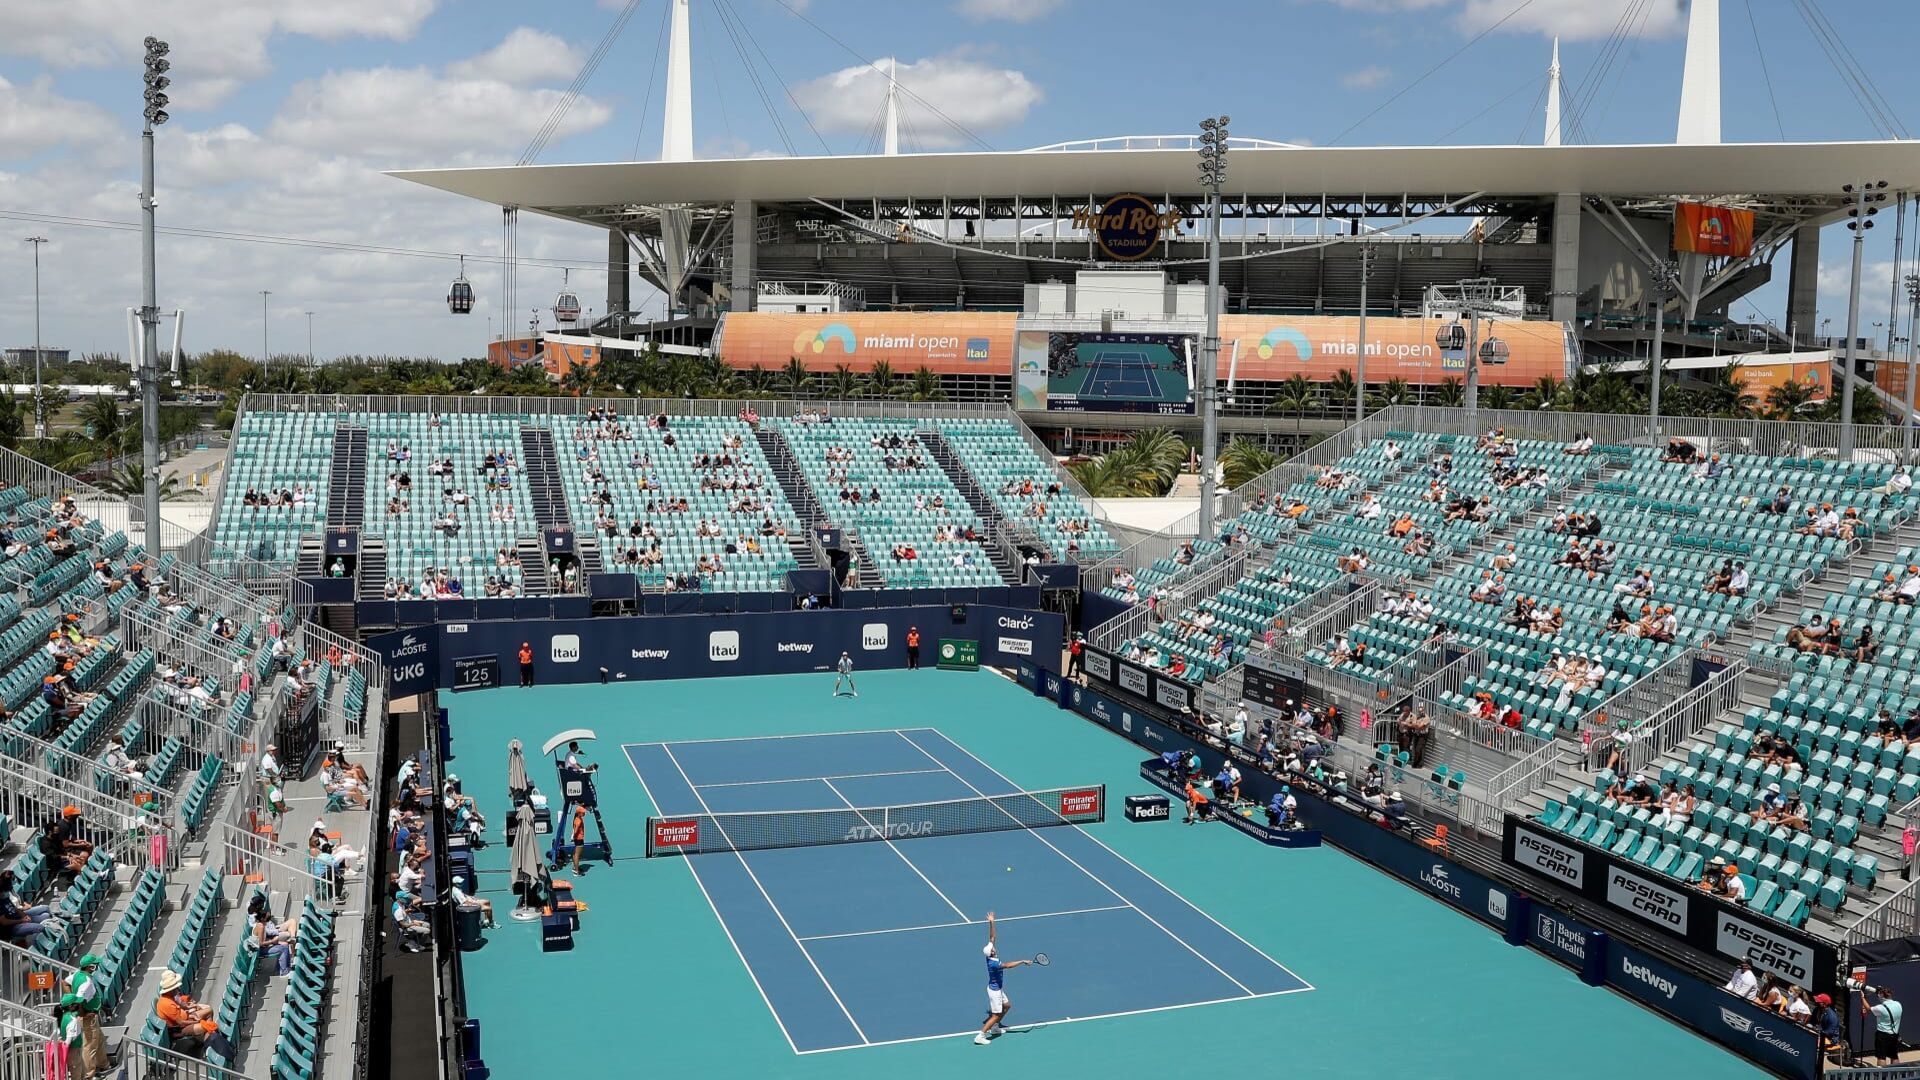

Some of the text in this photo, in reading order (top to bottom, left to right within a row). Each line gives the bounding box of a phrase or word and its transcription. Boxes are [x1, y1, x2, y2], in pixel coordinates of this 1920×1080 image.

[1072, 207, 1181, 235] Hard Rock
[1108, 239, 1147, 247] STADIUM
[864, 334, 958, 351] miami open
[1321, 339, 1431, 360] miami open
[967, 349, 988, 358] Itaú
[1443, 356, 1465, 368] Itaú
[998, 616, 1029, 630] Claro
[778, 643, 813, 653] betway
[865, 636, 886, 646] Itaú
[392, 643, 427, 658] LACOSTE
[553, 648, 577, 658] Itaú
[632, 649, 669, 659] betway
[711, 645, 737, 656] Itaú
[1087, 654, 1107, 668] ASSIST
[463, 667, 489, 683] 125
[1093, 664, 1109, 676] CARD
[1121, 668, 1144, 682] ASSIST
[1128, 679, 1146, 692] CARD
[1159, 684, 1183, 699] ASSIST
[1166, 696, 1185, 709] CARD
[1091, 706, 1111, 723] LACOSTE
[1063, 796, 1095, 805] Emirates
[1135, 804, 1168, 818] FedEx
[657, 825, 695, 836] Emirates
[845, 821, 933, 840] ATP TOUR
[1519, 835, 1576, 863] ASSIST
[1536, 855, 1578, 880] CARD
[1420, 872, 1461, 898] LACOSTE
[1613, 875, 1679, 908] ASSIST
[1489, 900, 1505, 915] Itaú
[1632, 896, 1682, 925] CARD
[1558, 922, 1586, 945] Baptis
[1723, 921, 1802, 960] ASSIST
[1557, 935, 1585, 959] Health
[1746, 947, 1806, 980] CARD
[37, 977, 46, 985] 12
[1622, 957, 1678, 999] betway
[1753, 1026, 1801, 1057] Cadillac
